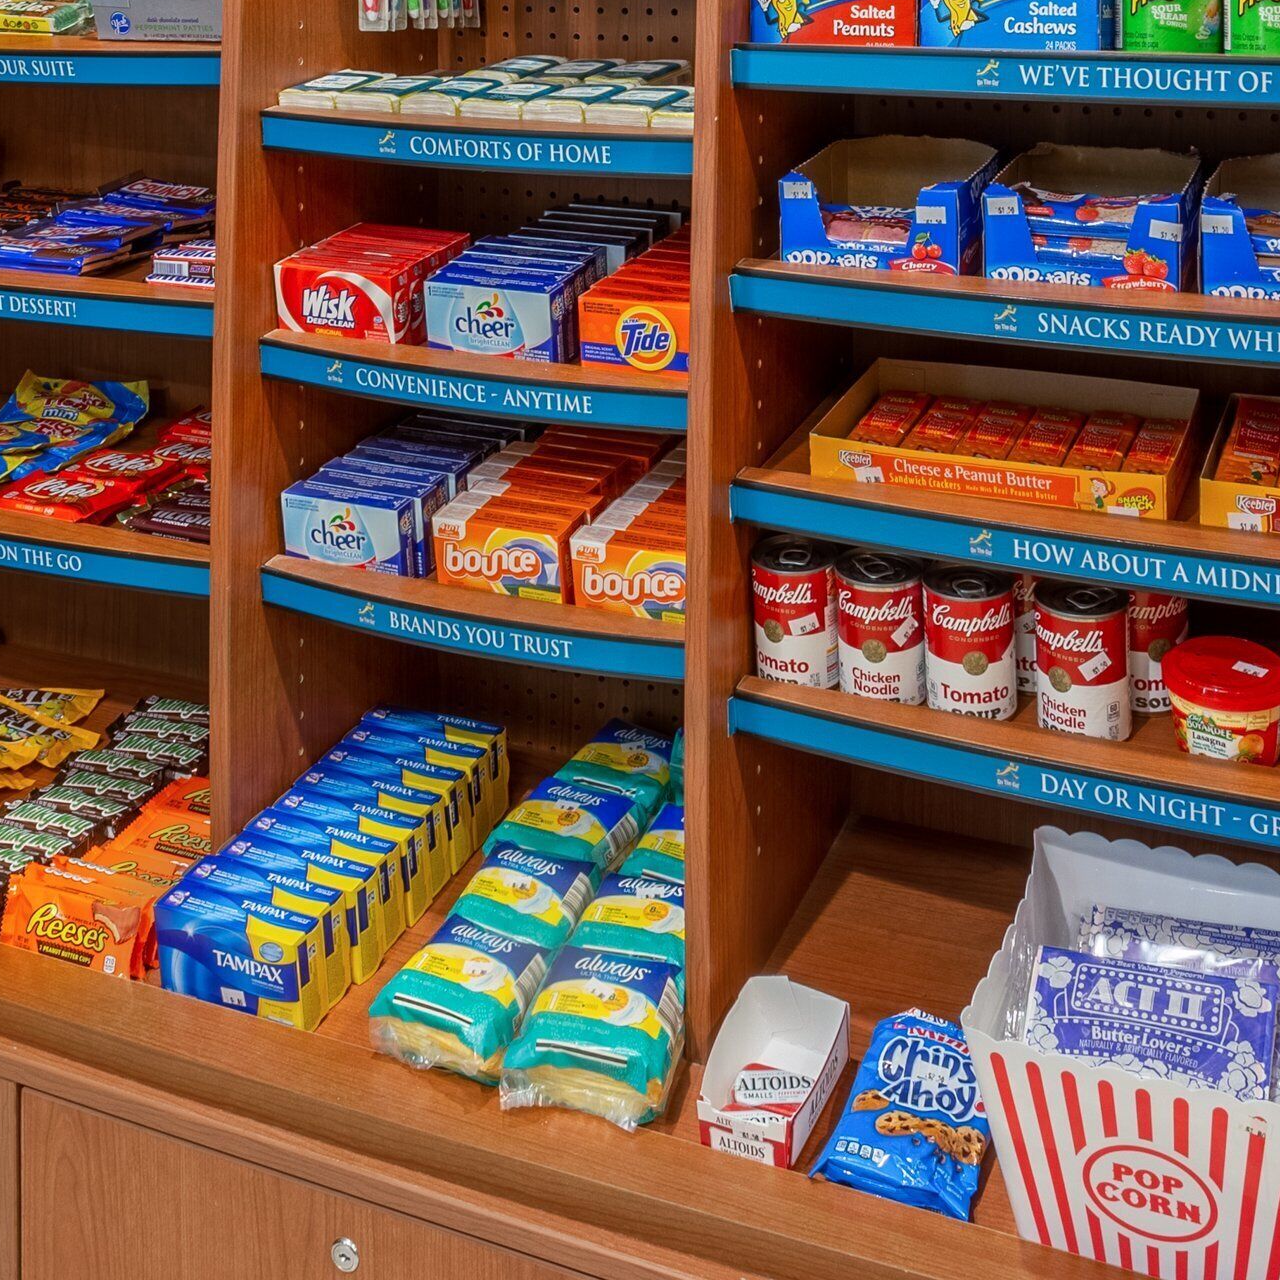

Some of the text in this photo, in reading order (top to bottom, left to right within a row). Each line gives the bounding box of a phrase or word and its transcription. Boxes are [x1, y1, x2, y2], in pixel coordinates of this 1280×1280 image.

[850, 5, 895, 21] Salted
[1029, 1, 1077, 18] Salted
[1150, 4, 1182, 15] SOUR
[1153, 12, 1189, 23] CREAM
[135, 24, 177, 32] PEPPERMINT
[833, 20, 895, 38] Peanuts
[1004, 17, 1077, 36] Cashews
[1045, 41, 1076, 51] 24 PACKS
[29, 60, 75, 77] SUITE
[1019, 63, 1090, 89] WE'VE
[1097, 66, 1232, 92] THOUGHT
[1237, 69, 1272, 93] OF
[410, 136, 611, 164] COMFORTS OF HOME
[902, 262, 938, 271] Cherry
[11, 296, 77, 319] DESSERT!
[303, 285, 356, 322] Wisk
[306, 316, 355, 329] DEEP CLEAN
[455, 308, 515, 341] cheer
[1038, 313, 1130, 340] SNACKS
[1139, 322, 1220, 347] READY
[620, 322, 670, 358] Tide
[355, 368, 486, 403] CONVENIENCE
[504, 390, 592, 414] ANYTIME
[43, 407, 78, 421] mini
[840, 451, 871, 466] Keebler
[894, 458, 1052, 490] Cheese & Peanut Butter
[311, 526, 366, 553] cheer
[22, 546, 53, 567] THE
[55, 552, 82, 572] GO
[446, 544, 536, 577] bounce
[1013, 539, 1074, 568] HOW
[1080, 546, 1166, 579] ABOUT
[1172, 557, 1189, 582] A
[389, 611, 572, 658] BRANDS YOU TRUST
[852, 667, 901, 684] Chicken
[853, 679, 900, 695] Noodle
[941, 683, 1009, 704] Tomato
[1191, 733, 1227, 748] Lasagna
[1040, 773, 1088, 798] DAY
[1093, 782, 1134, 807] OR
[1139, 788, 1226, 827] NIGHT
[240, 899, 288, 921] TAMPAX
[451, 921, 518, 954] always
[211, 949, 284, 985] TAMPAX
[574, 953, 647, 982] always
[1082, 977, 1207, 1021] ACT II
[1079, 1039, 1114, 1050] NATURALLY
[1123, 1045, 1163, 1060] ARTIFICIALLY
[1165, 1053, 1198, 1068] FLAVORED
[1092, 1025, 1191, 1056] Butter Lovers
[737, 1073, 811, 1090] ALTOIDS
[1111, 1161, 1184, 1194] POP
[1096, 1181, 1203, 1225] CORN
